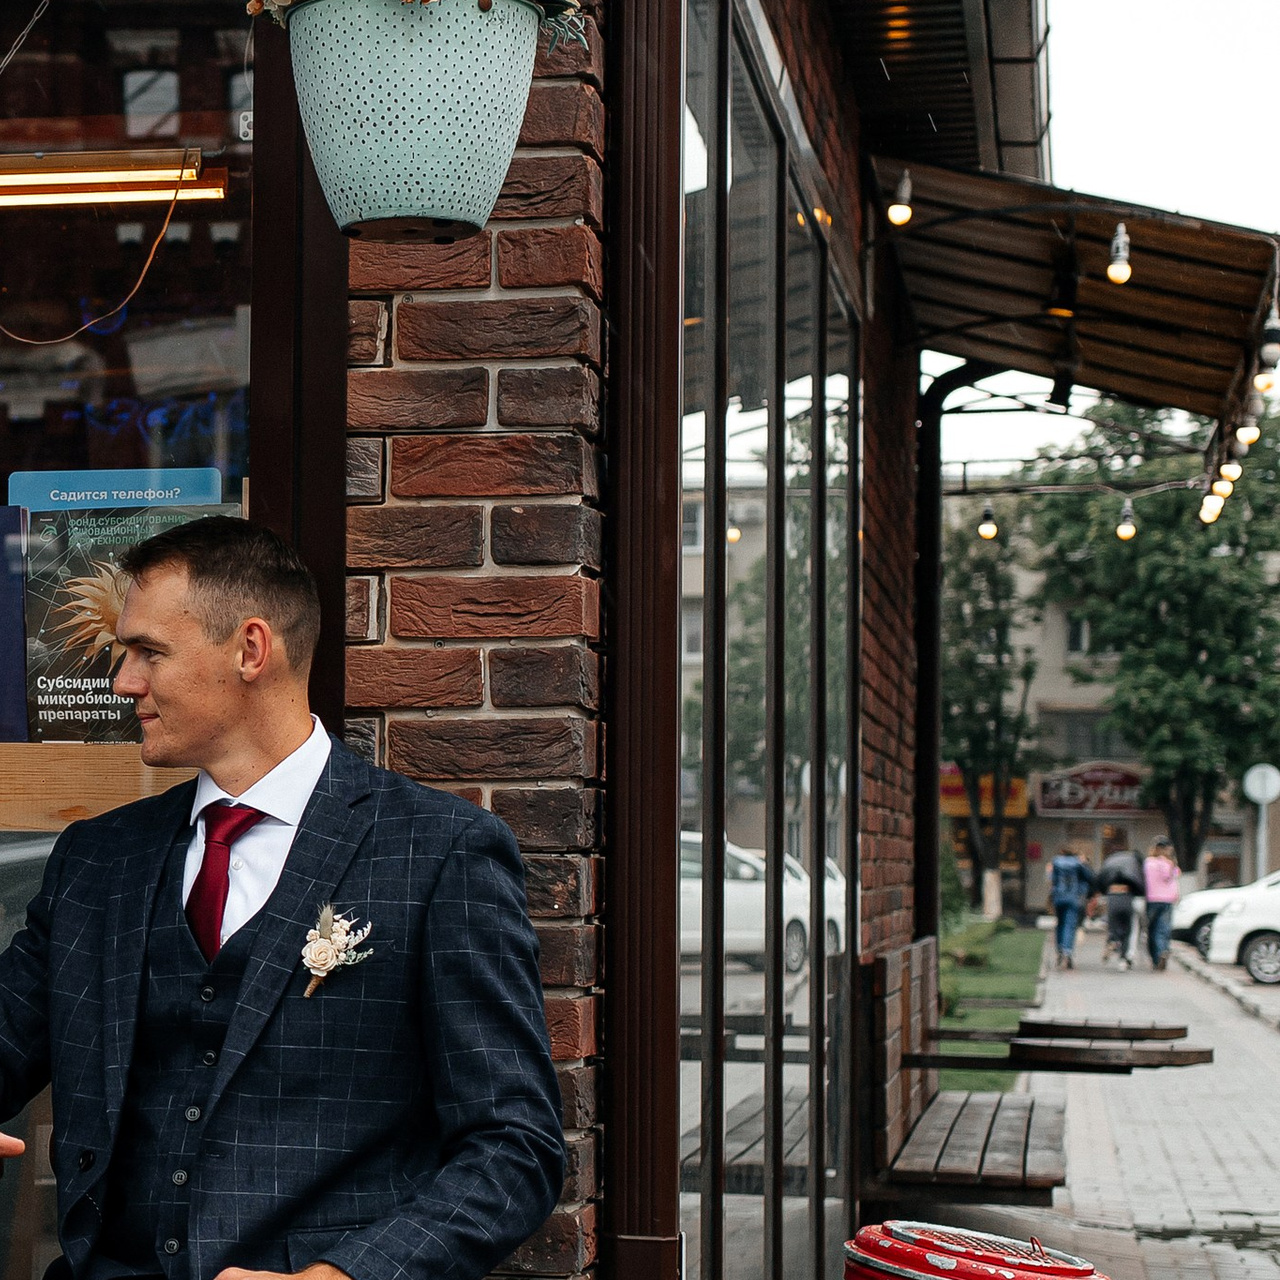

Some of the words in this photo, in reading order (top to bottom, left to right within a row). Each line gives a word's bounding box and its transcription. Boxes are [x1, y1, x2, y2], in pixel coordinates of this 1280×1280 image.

[49, 489, 108, 503] Садится
[111, 487, 181, 502] телефон?
[68, 518, 97, 528] ФОНД
[37, 675, 110, 692] Субсидии
[38, 709, 121, 723] препараты
